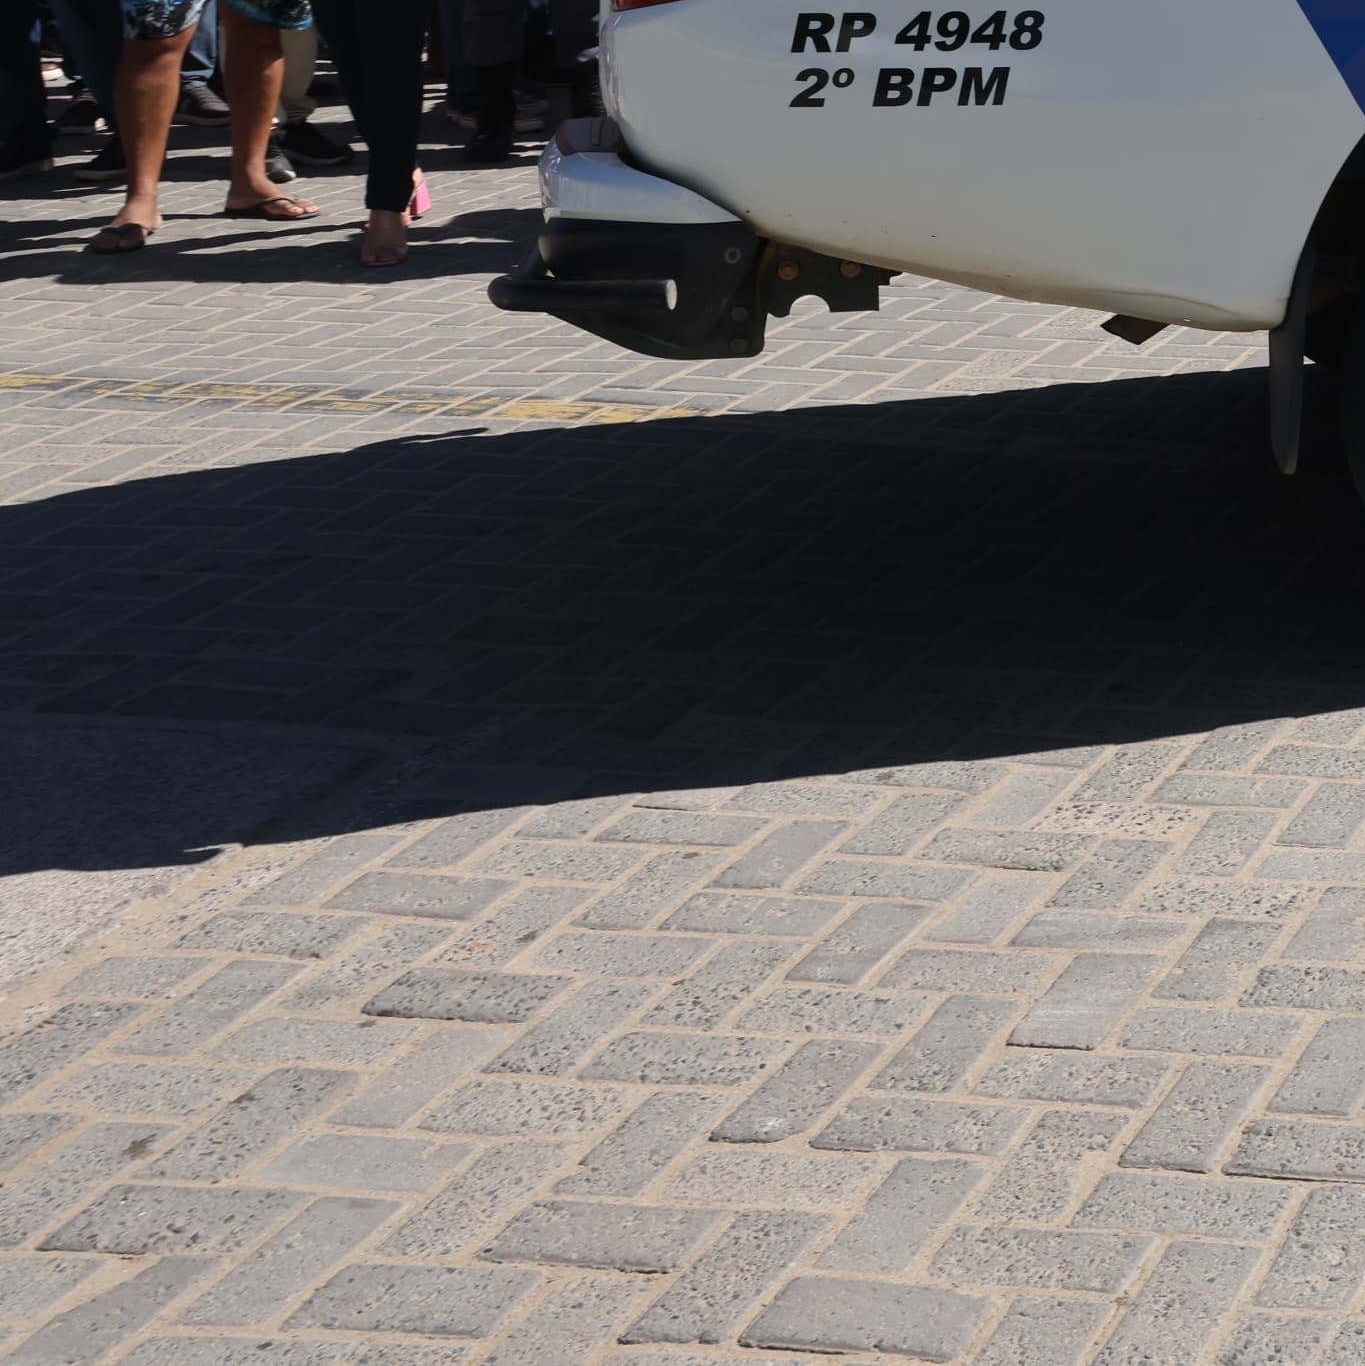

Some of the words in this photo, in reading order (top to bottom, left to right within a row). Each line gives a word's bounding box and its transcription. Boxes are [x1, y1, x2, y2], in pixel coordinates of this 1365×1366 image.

[791, 12, 878, 54] RP
[894, 10, 1046, 52] 4948
[788, 67, 856, 108] 2º
[872, 66, 1012, 107] BPM
